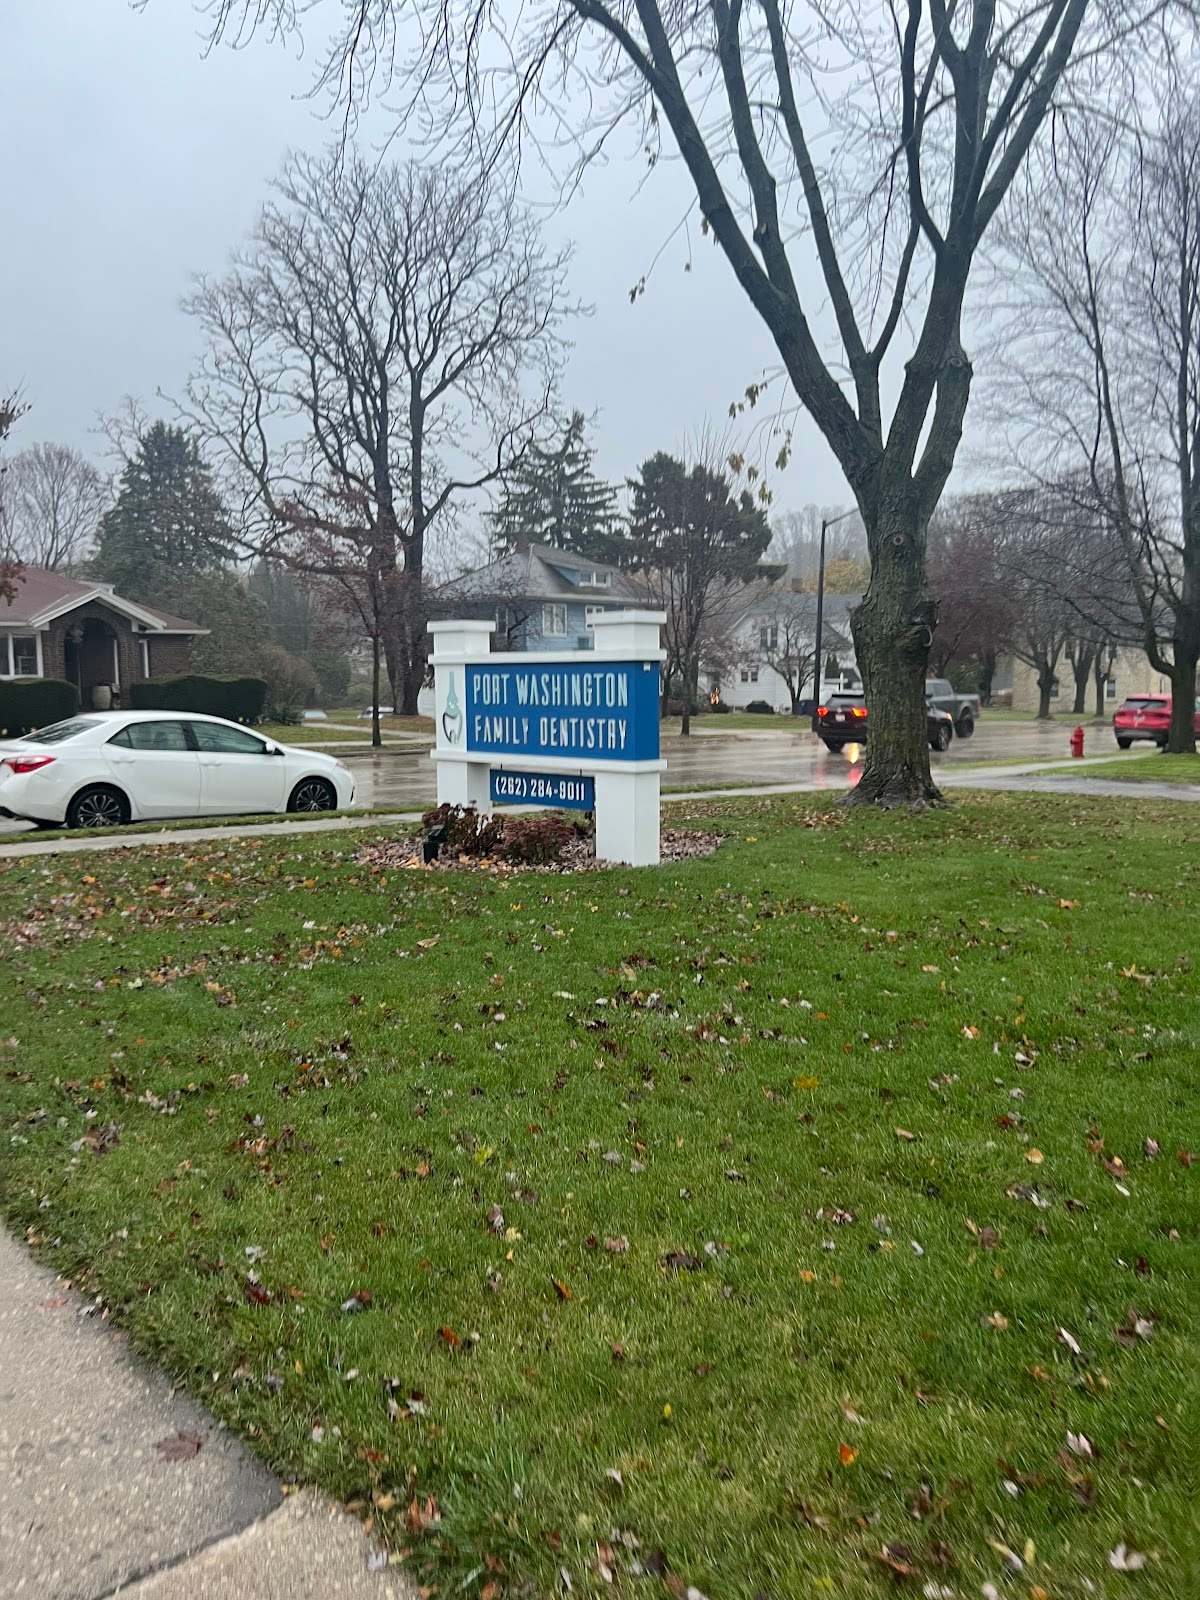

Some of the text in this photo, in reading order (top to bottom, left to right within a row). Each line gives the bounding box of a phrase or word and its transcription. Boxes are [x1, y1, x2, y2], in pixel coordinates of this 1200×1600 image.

[473, 673, 628, 707] PORT WASHINGTON
[474, 715, 627, 750] FAMILY DENTISTRY
[495, 776, 585, 801] (262) 284-9011
